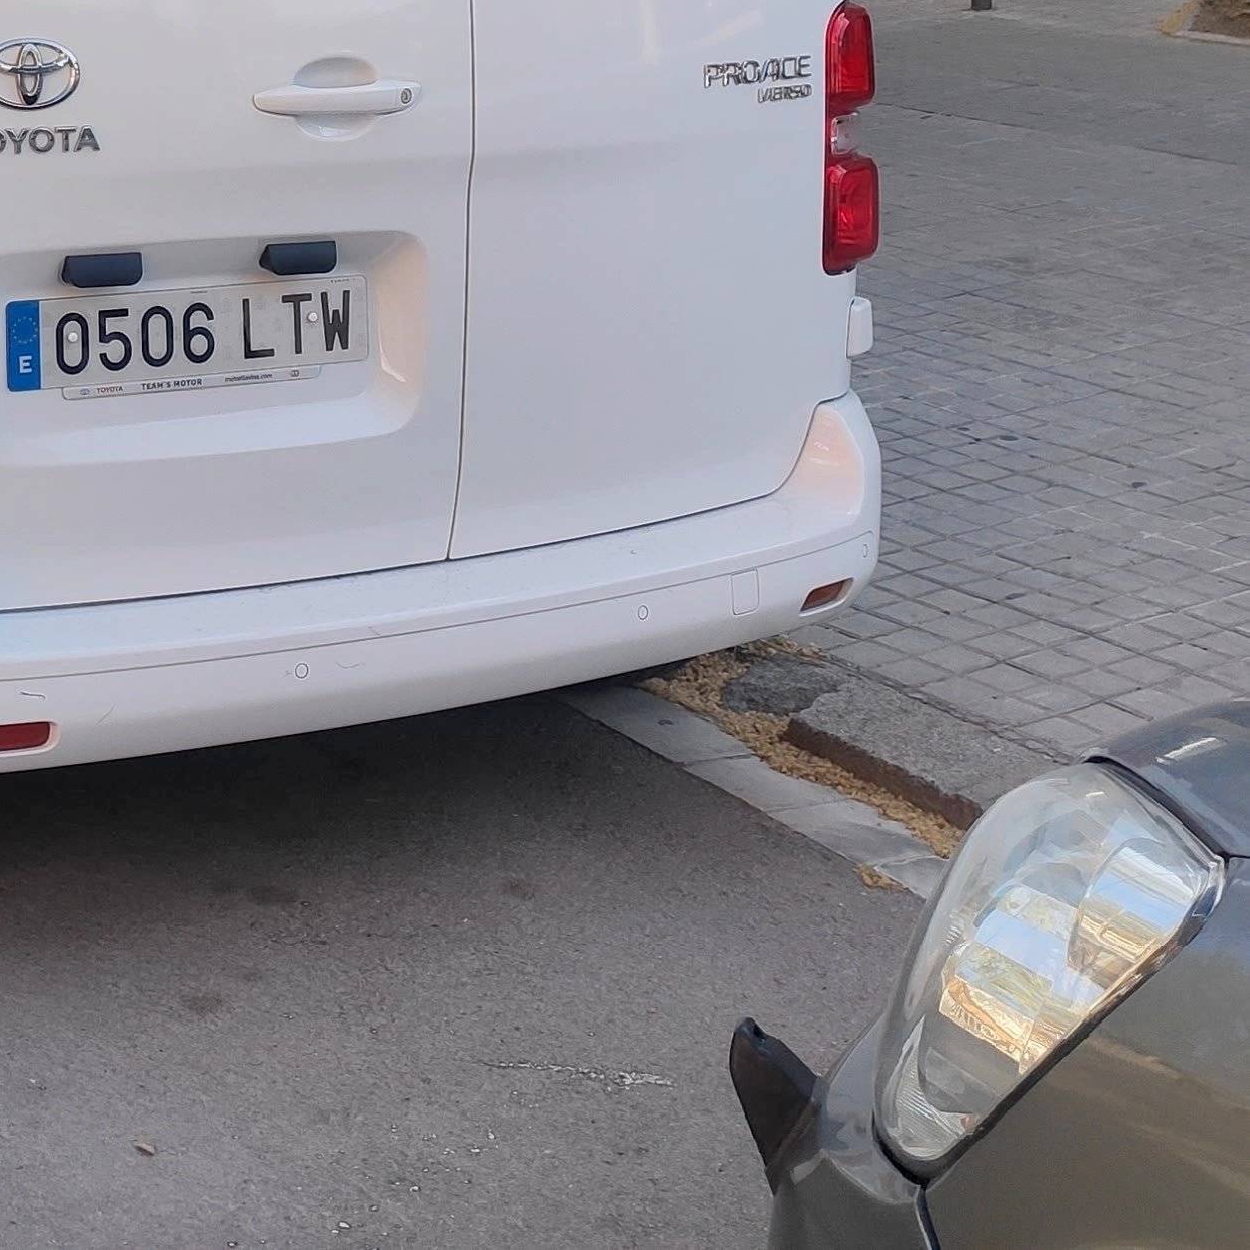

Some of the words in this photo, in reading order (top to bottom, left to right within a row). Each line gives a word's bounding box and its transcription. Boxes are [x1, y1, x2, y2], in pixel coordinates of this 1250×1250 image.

[703, 55, 812, 88] PROACE
[758, 84, 813, 103] VERSO
[19, 355, 32, 373] E
[55, 302, 216, 376] 0506
[243, 289, 351, 360] LTW
[96, 385, 124, 395] TOYOTA
[173, 378, 203, 389] MOTOR
